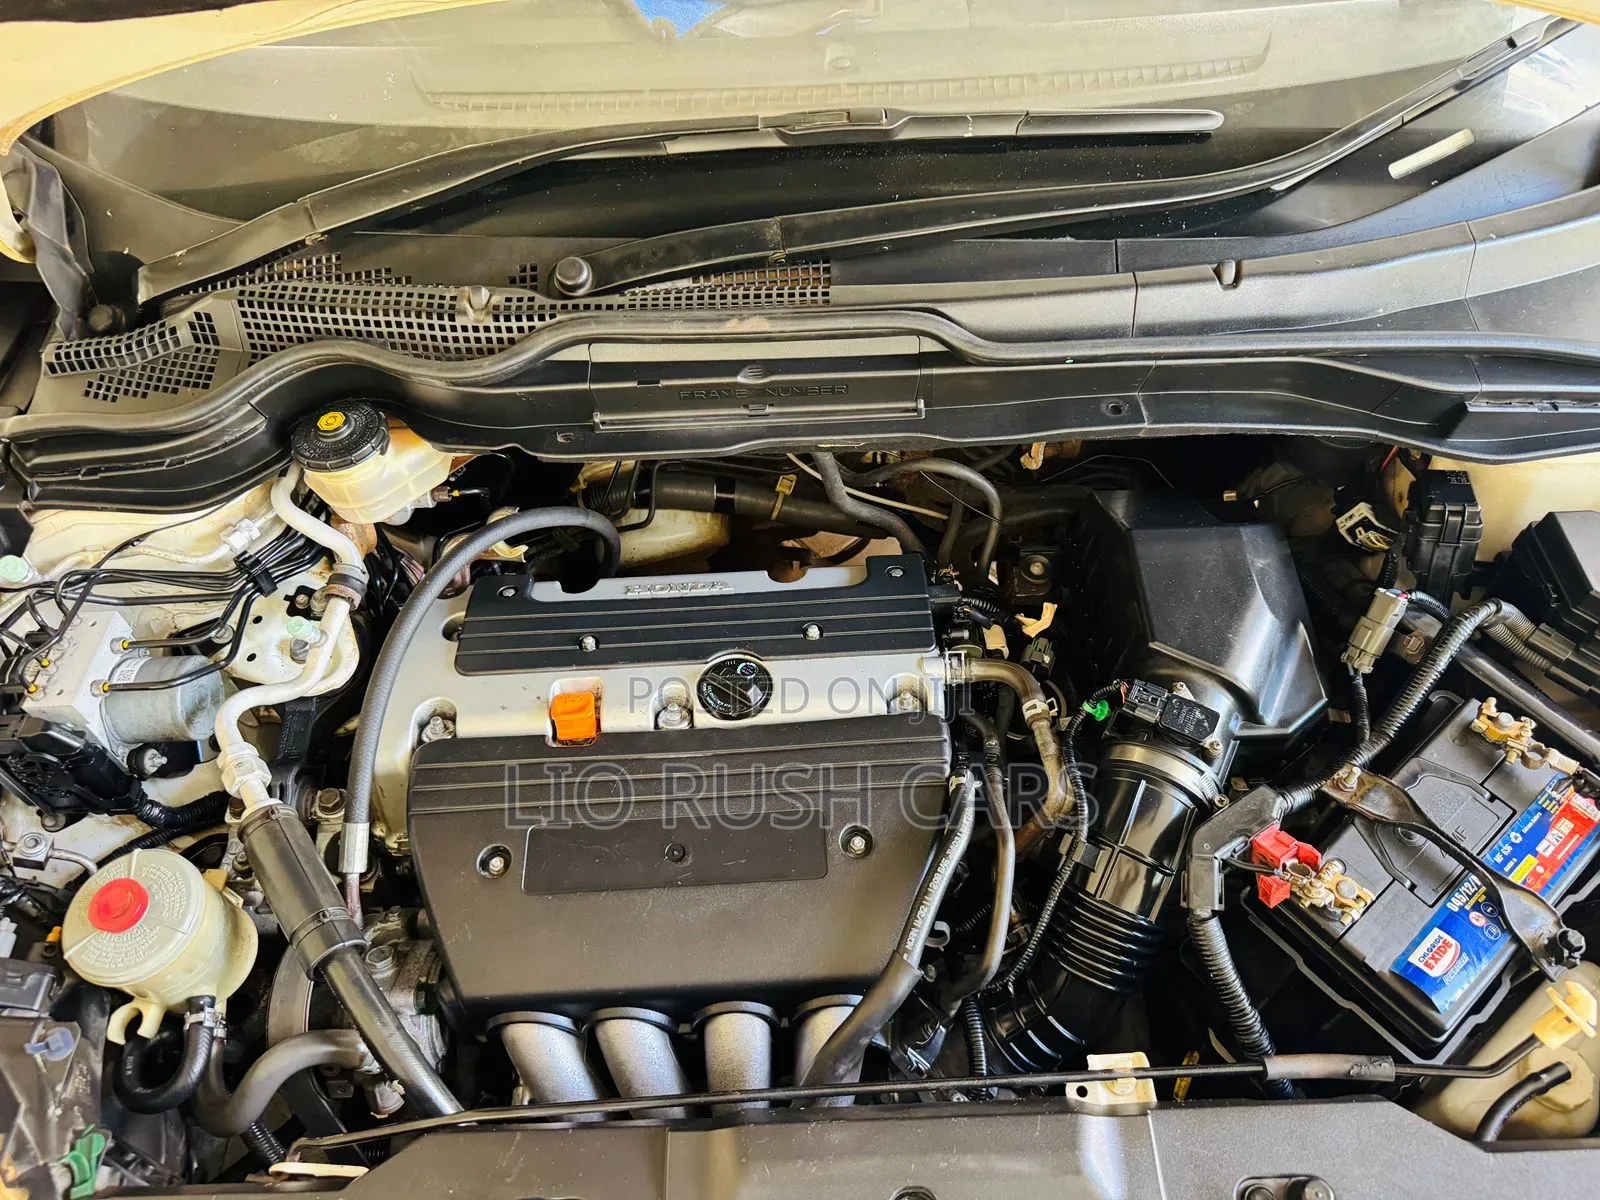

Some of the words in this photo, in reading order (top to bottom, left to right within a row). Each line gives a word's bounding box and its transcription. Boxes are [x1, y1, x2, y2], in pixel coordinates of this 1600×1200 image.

[679, 388, 748, 401] FRAME
[765, 385, 848, 397] NUMBER
[624, 581, 734, 597] HONDA
[1418, 934, 1444, 963] CHLORIDE
[1423, 937, 1453, 971] EXIDE
